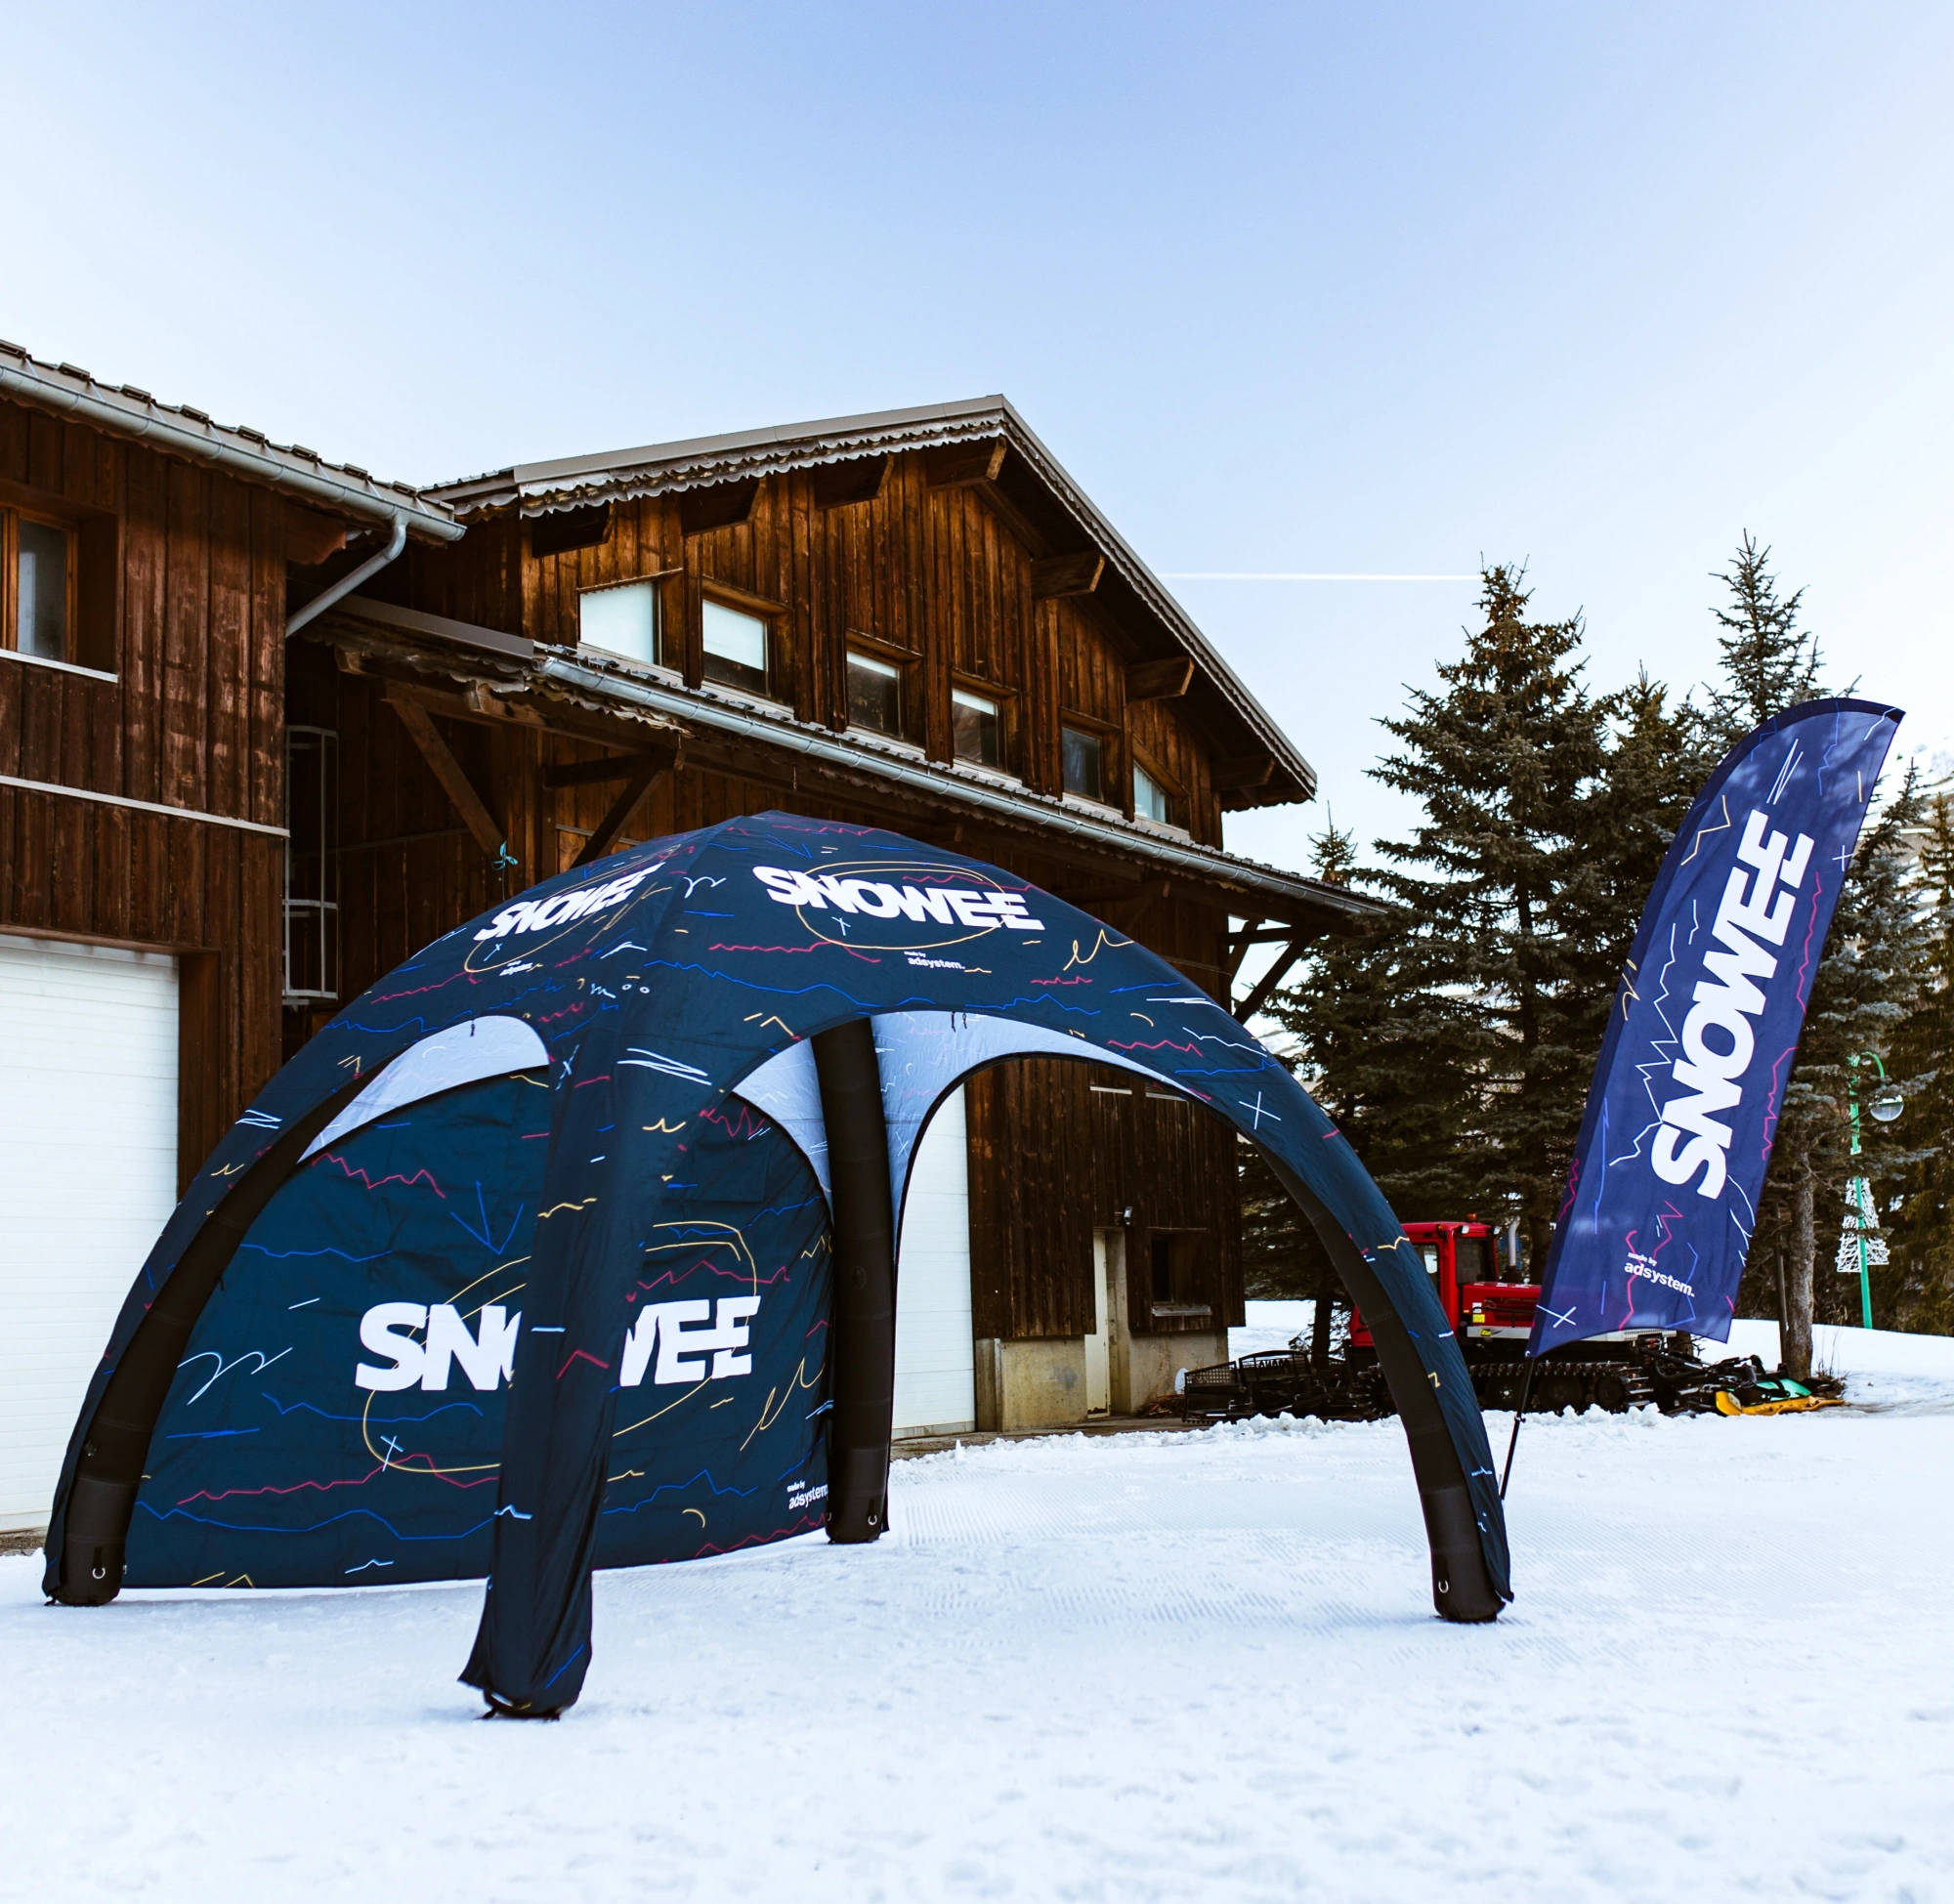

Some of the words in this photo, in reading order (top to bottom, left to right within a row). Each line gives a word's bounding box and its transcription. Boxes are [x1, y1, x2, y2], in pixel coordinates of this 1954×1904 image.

[473, 862, 666, 942] SNOWEE
[752, 866, 1045, 932] SNOWEE
[908, 956, 966, 970] adsystem.
[1650, 808, 1815, 1201] SNOWEE
[1624, 1261, 1696, 1298] adsystem.
[1647, 1256, 1658, 1267] by
[356, 1294, 761, 1391] SNEE
